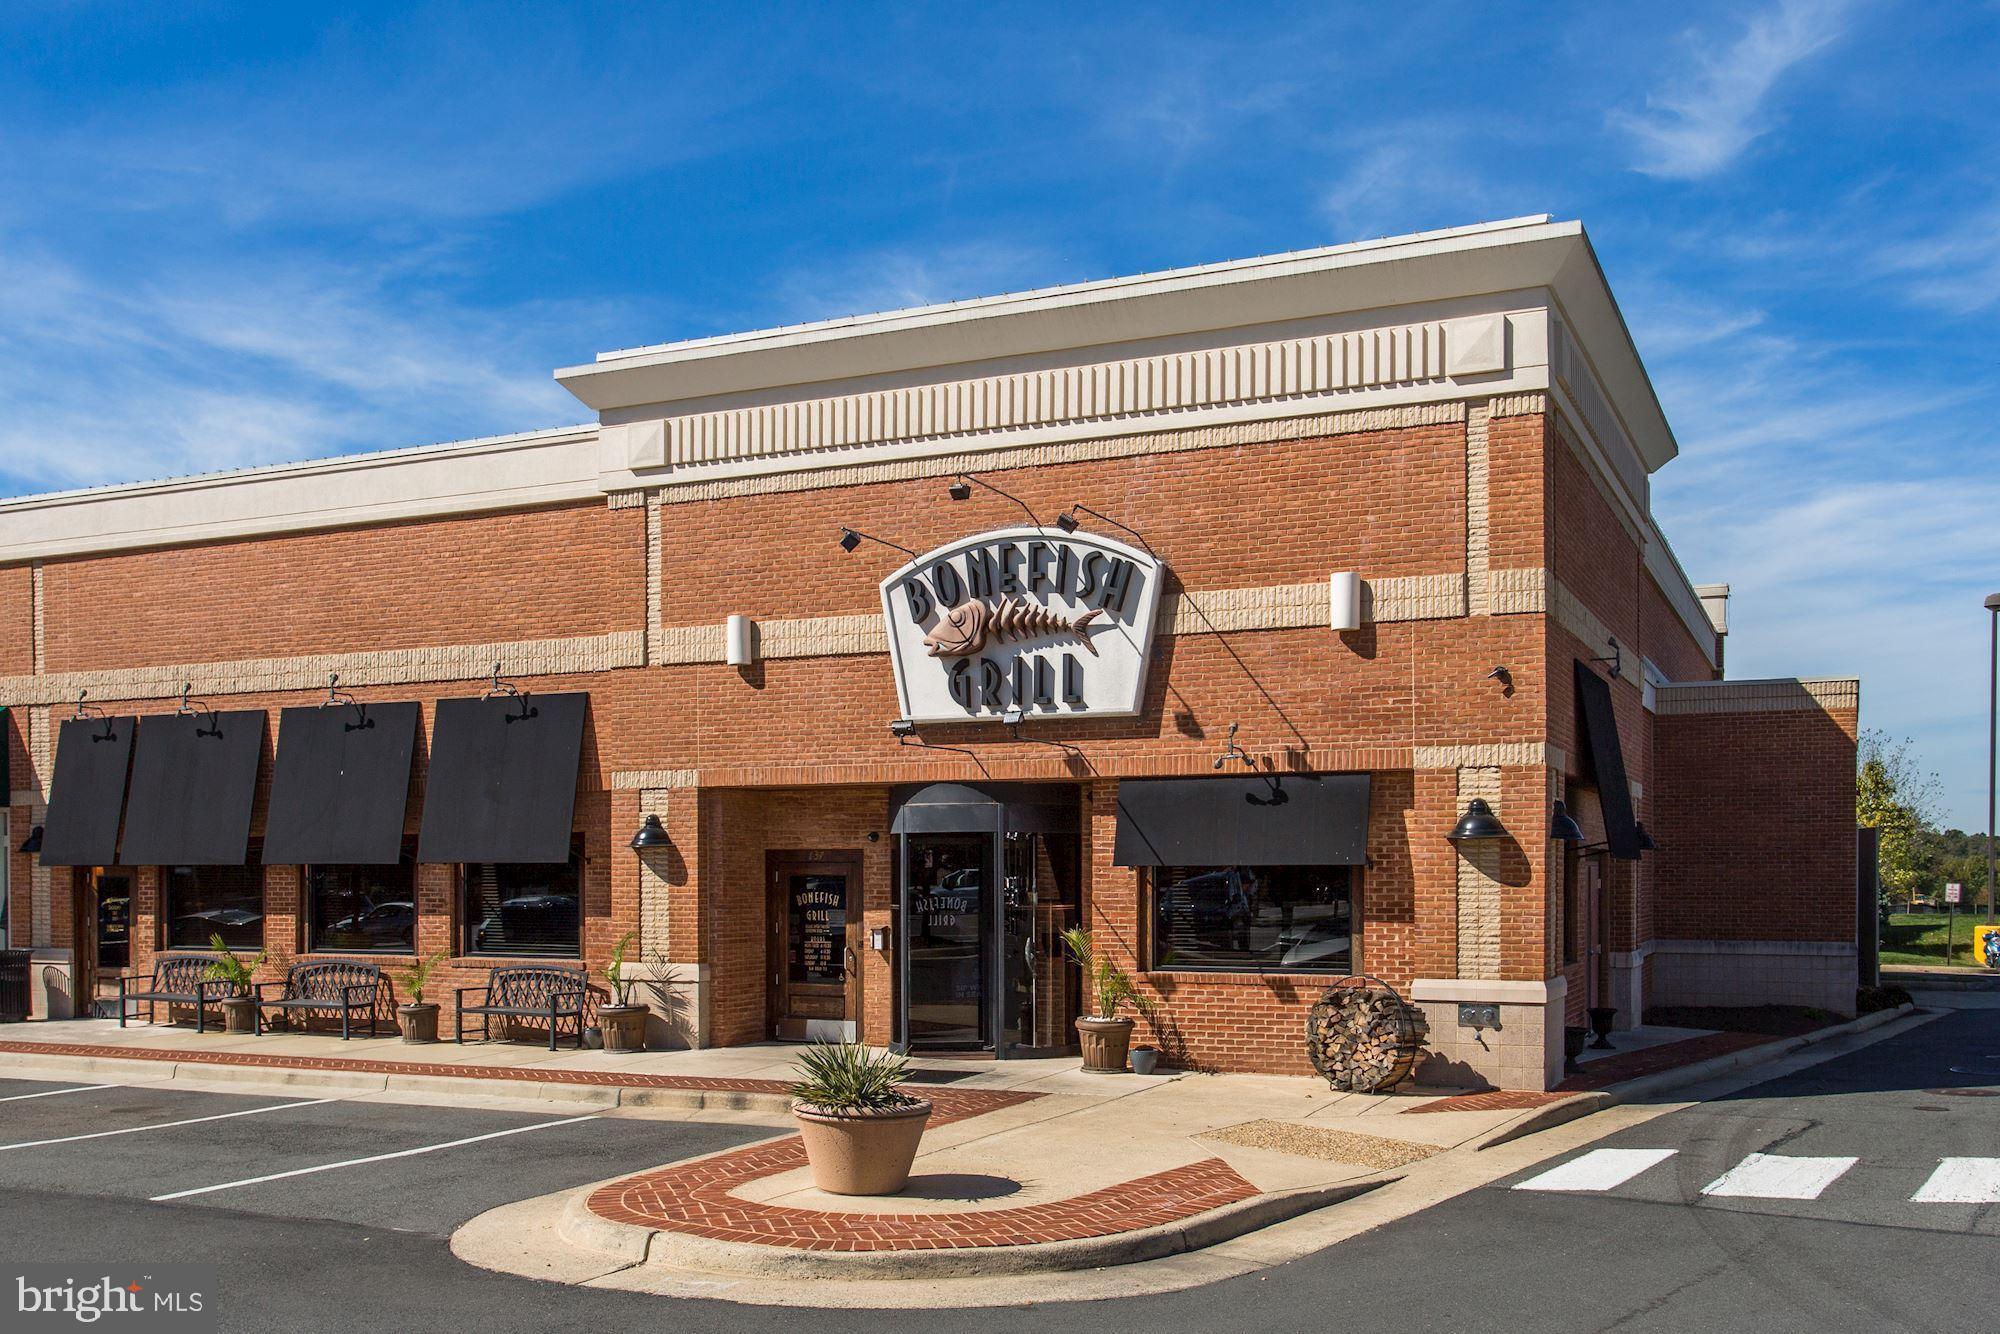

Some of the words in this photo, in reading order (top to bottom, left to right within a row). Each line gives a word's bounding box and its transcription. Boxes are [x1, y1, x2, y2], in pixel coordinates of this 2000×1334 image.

[902, 541, 1135, 624] BONEFISH
[950, 653, 1082, 709] GRILL
[796, 891, 840, 907] BONEFISH
[806, 910, 830, 922] GRILL
